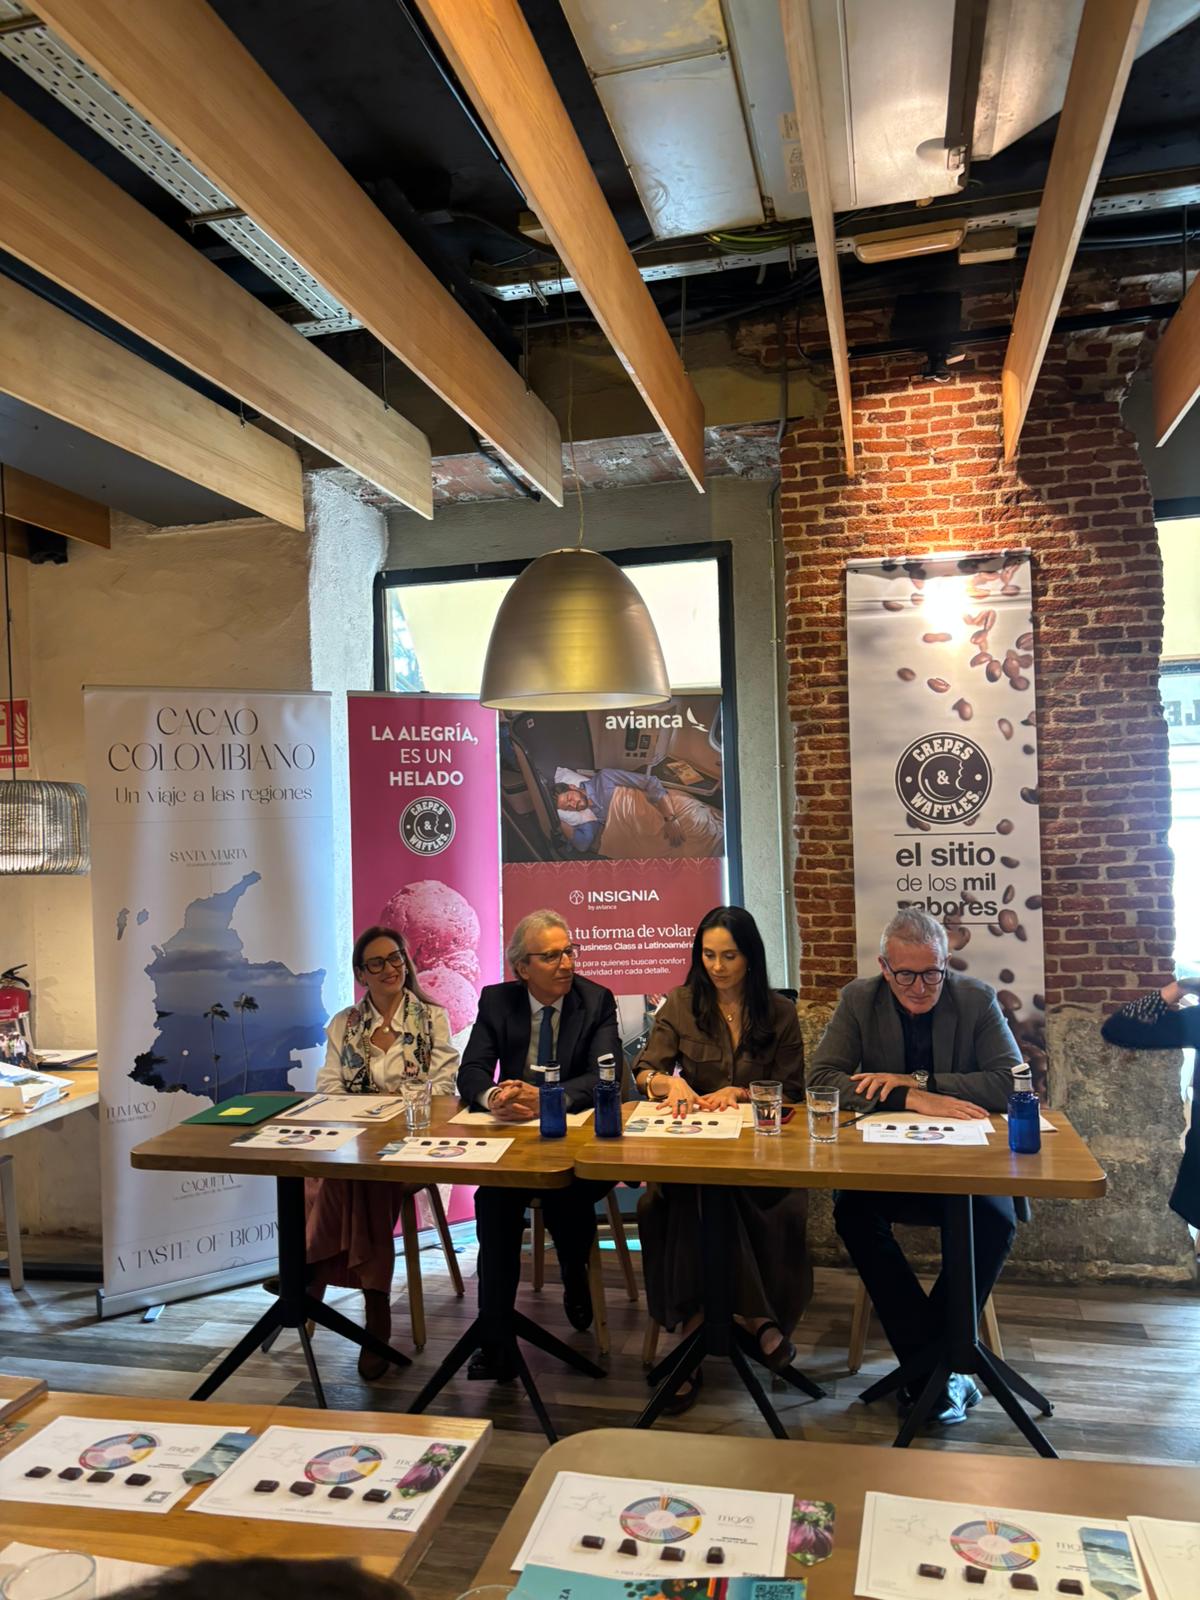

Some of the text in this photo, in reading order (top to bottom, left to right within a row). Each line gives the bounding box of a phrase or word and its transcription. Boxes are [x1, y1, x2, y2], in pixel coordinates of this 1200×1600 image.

[156, 706, 259, 736] CACAO
[605, 710, 683, 730] avianca
[371, 722, 479, 746] LA ALEGRÍA,
[107, 742, 316, 772] COLOMBIANO
[400, 748, 452, 764] ES UN
[911, 738, 974, 762] CREPES
[389, 770, 464, 787] HELADO
[936, 769, 950, 785] &
[115, 784, 313, 807] Un viaje a las regiones
[409, 801, 445, 816] CREPES
[909, 790, 980, 819] WAFFLES
[423, 820, 432, 831] &
[408, 833, 448, 851] WAFFLES
[895, 841, 996, 867] el sitio
[896, 872, 996, 892] de los mil
[588, 889, 660, 903] INSIGNIA
[575, 927, 590, 940] tu
[592, 925, 636, 940] forma
[637, 924, 655, 938] de
[657, 924, 696, 938] volar.
[613, 942, 637, 950] Class
[582, 960, 599, 968] para
[600, 958, 630, 967] quienes
[630, 957, 658, 966] buscan
[658, 957, 686, 965] confort
[624, 967, 643, 975] cada
